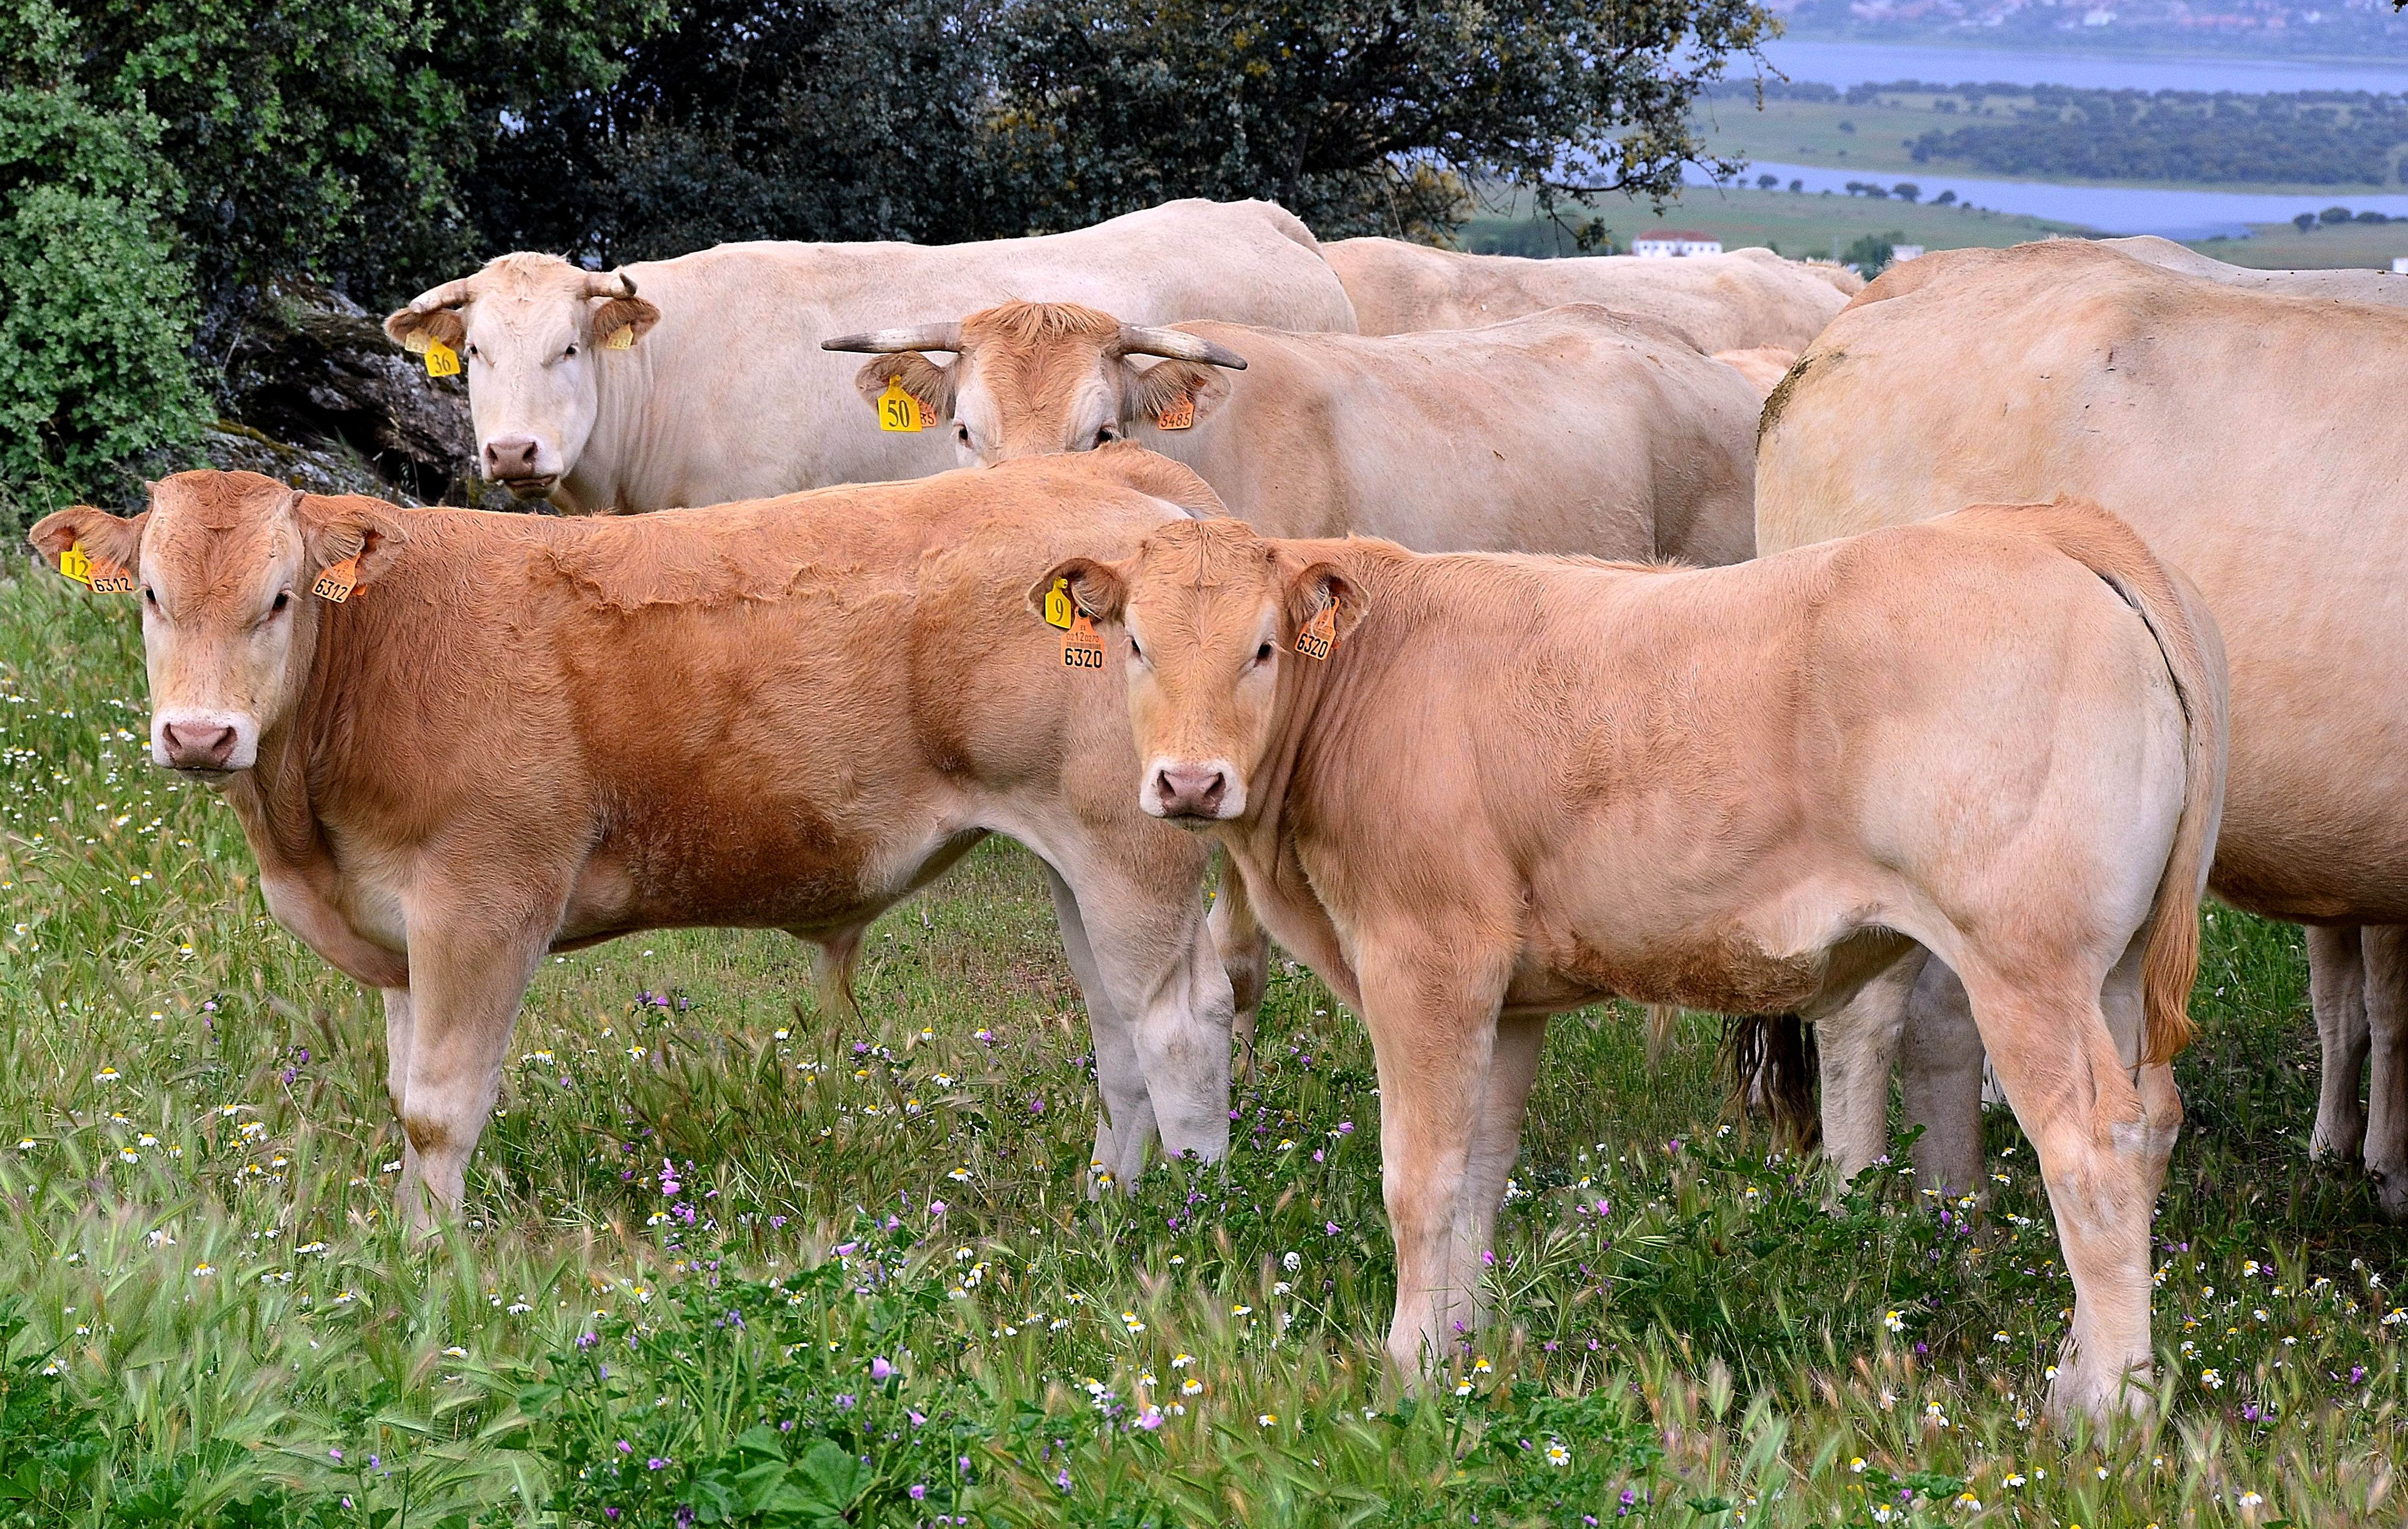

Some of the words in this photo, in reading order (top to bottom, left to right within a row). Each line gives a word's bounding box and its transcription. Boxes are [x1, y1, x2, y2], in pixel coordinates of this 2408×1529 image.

[432, 353, 451, 373] 36
[888, 400, 910, 428] 50
[920, 412, 934, 424] 85
[1161, 412, 1191, 427] 5485
[69, 556, 89, 578] 12
[95, 577, 133, 592] 6312
[315, 578, 348, 601] 6312
[1055, 598, 1064, 622] 9
[1297, 633, 1328, 658] 6320
[1065, 648, 1102, 669] 6320
